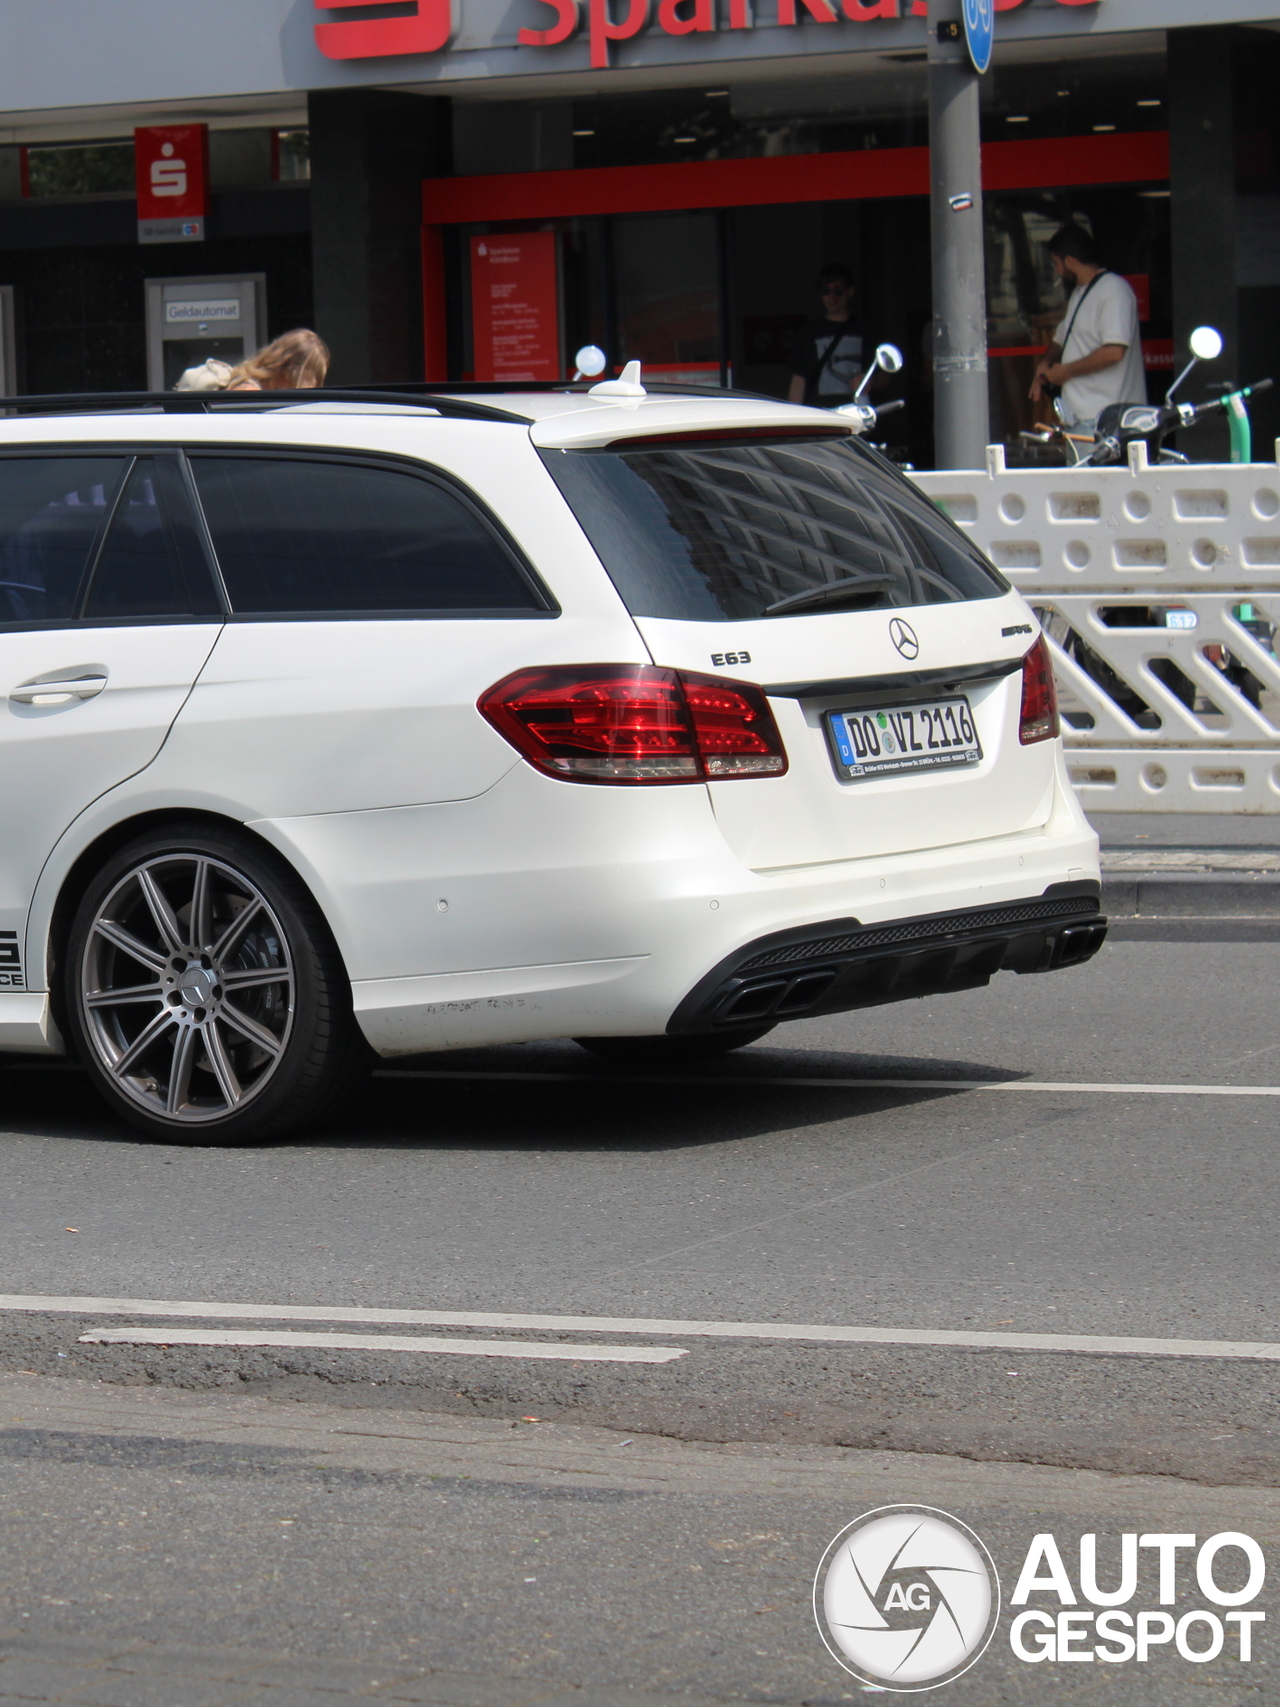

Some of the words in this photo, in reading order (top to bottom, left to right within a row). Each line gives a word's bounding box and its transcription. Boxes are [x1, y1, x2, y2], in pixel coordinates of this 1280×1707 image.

[169, 306, 237, 319] Geldautomat
[711, 651, 751, 667] E63
[847, 715, 880, 758] DO
[889, 711, 922, 753] VZ
[920, 705, 973, 748] 2116
[842, 745, 849, 757] D
